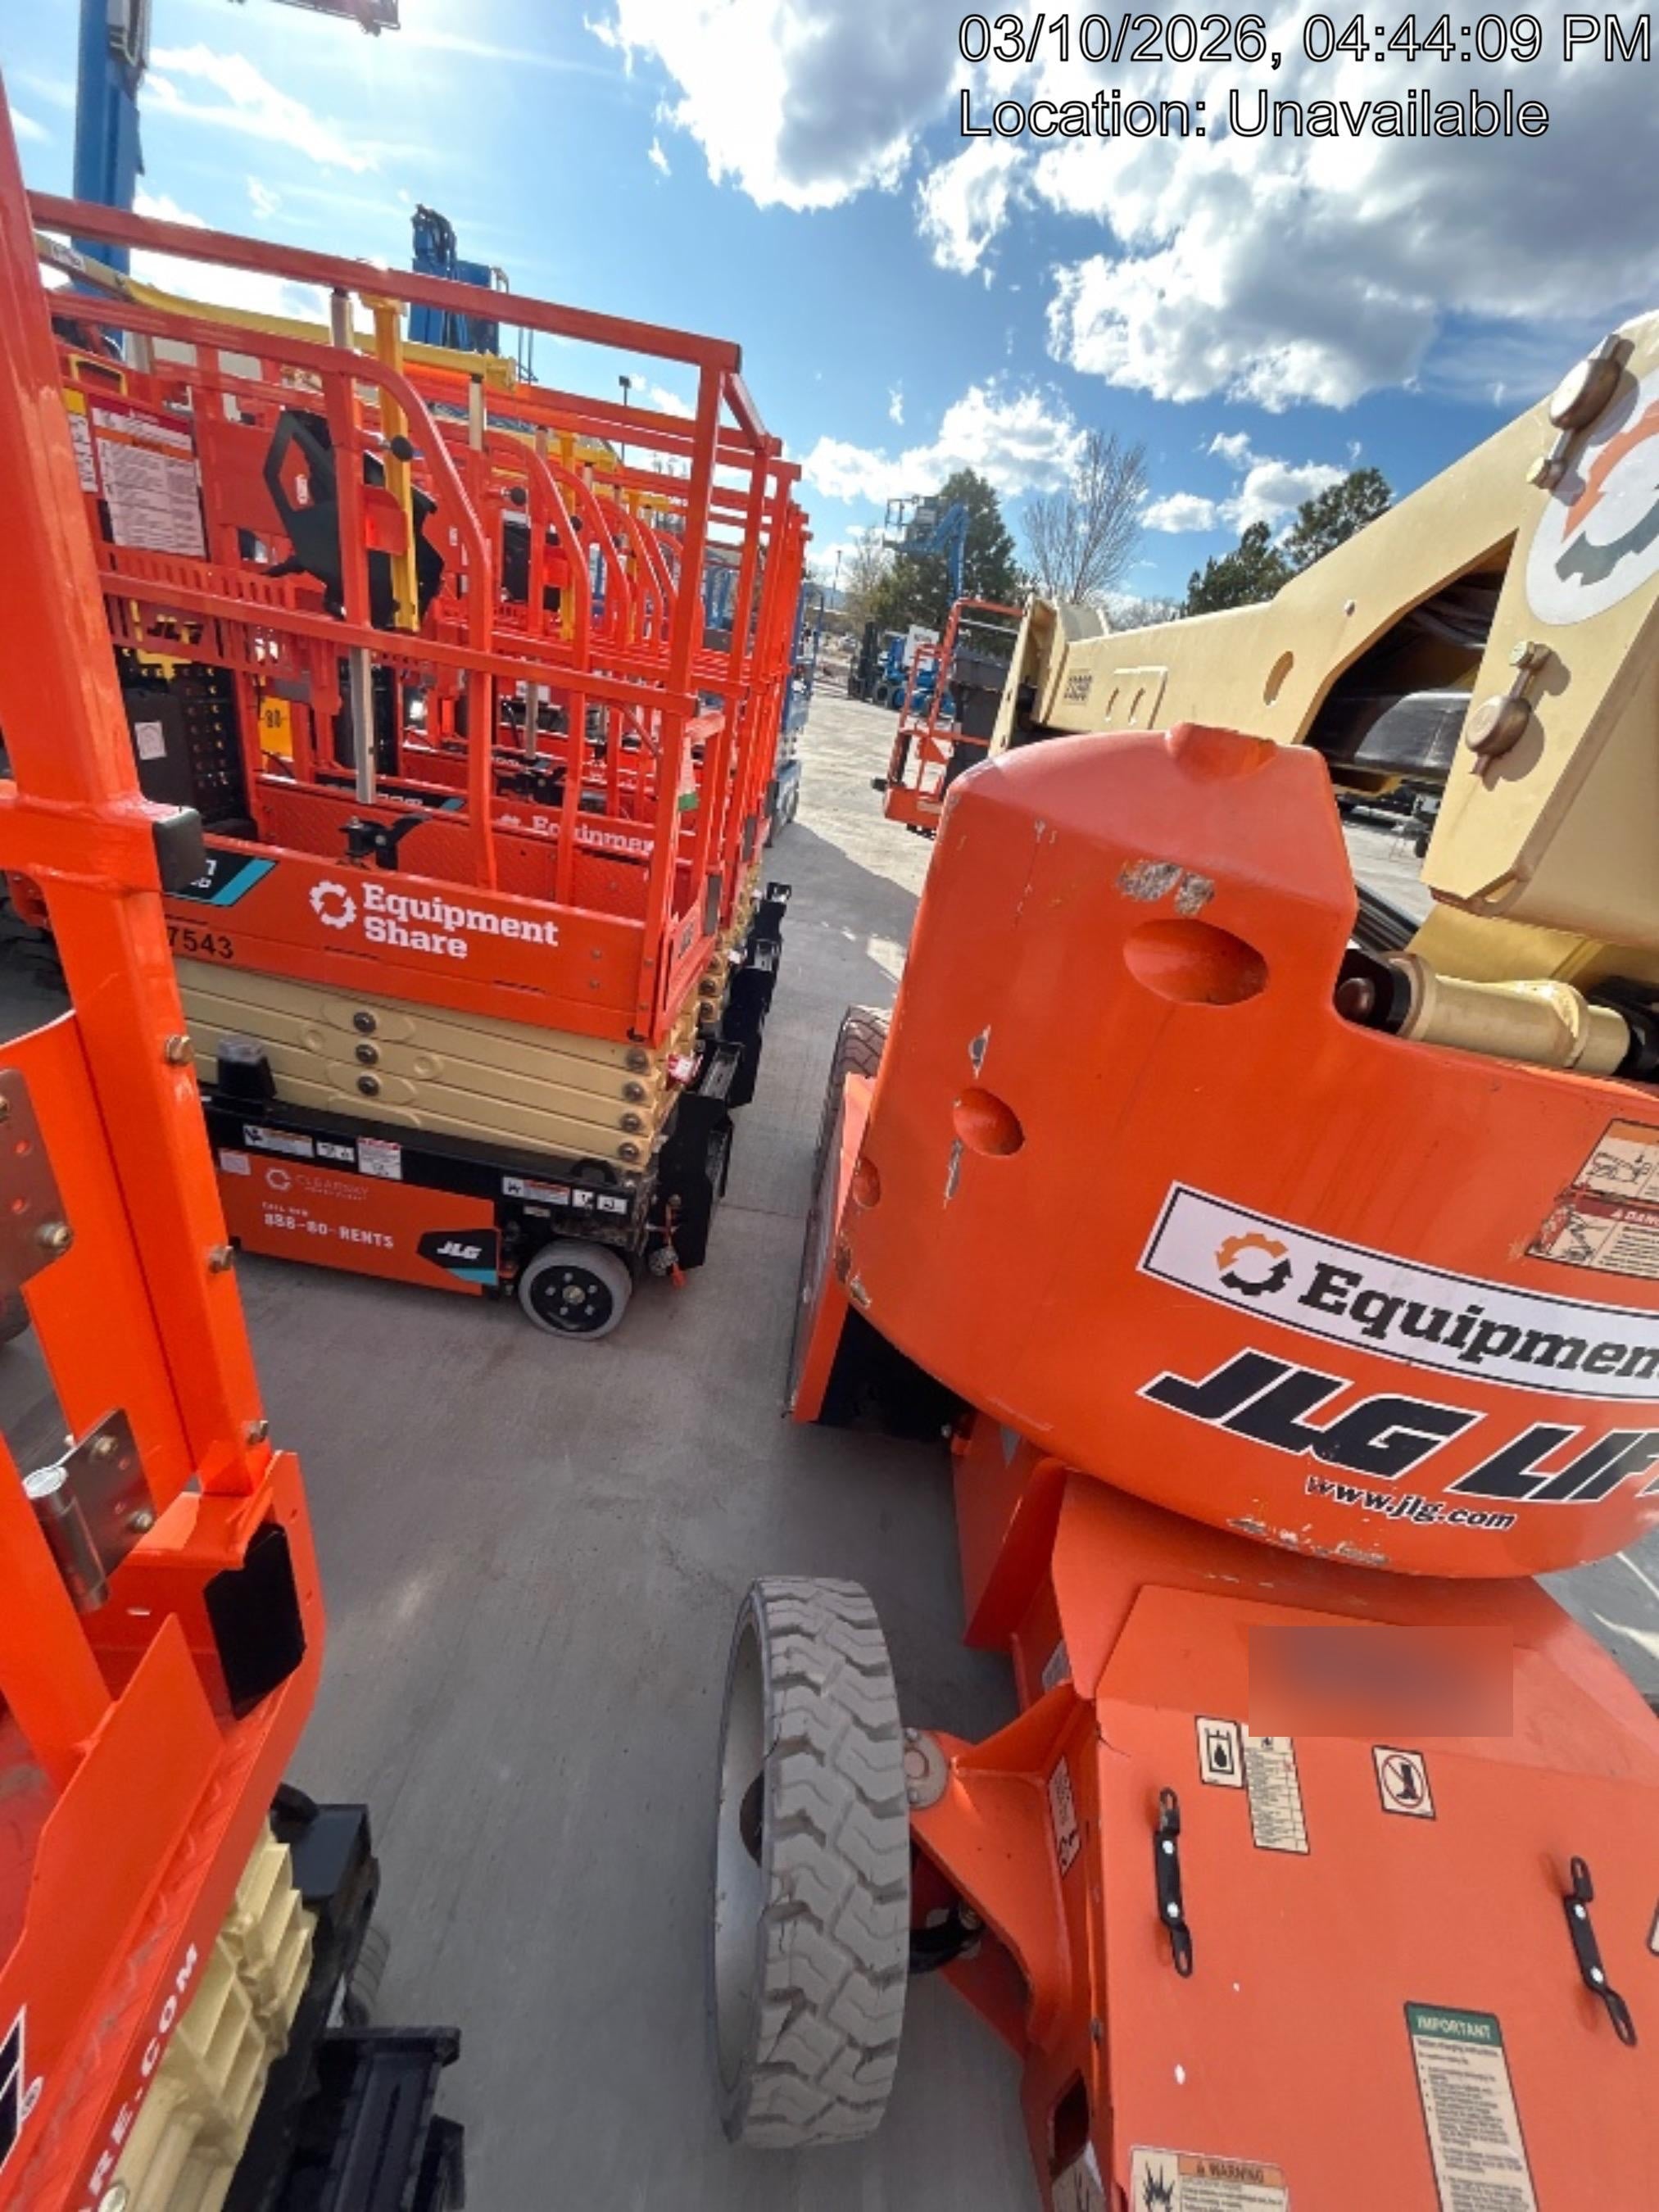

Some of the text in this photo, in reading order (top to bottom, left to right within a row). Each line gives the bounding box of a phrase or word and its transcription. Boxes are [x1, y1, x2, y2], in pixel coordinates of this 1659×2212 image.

[362, 882, 559, 946] Equipment
[364, 916, 468, 959] Share
[437, 1240, 483, 1260] JLG
[1298, 1261, 1659, 1379] Equipmen
[1135, 1346, 1489, 1480] JLG
[1304, 1475, 1519, 1530] www.jlg.com
[1417, 2015, 1491, 2040] IMPORTANT
[1208, 2162, 1265, 2184] WARNING
